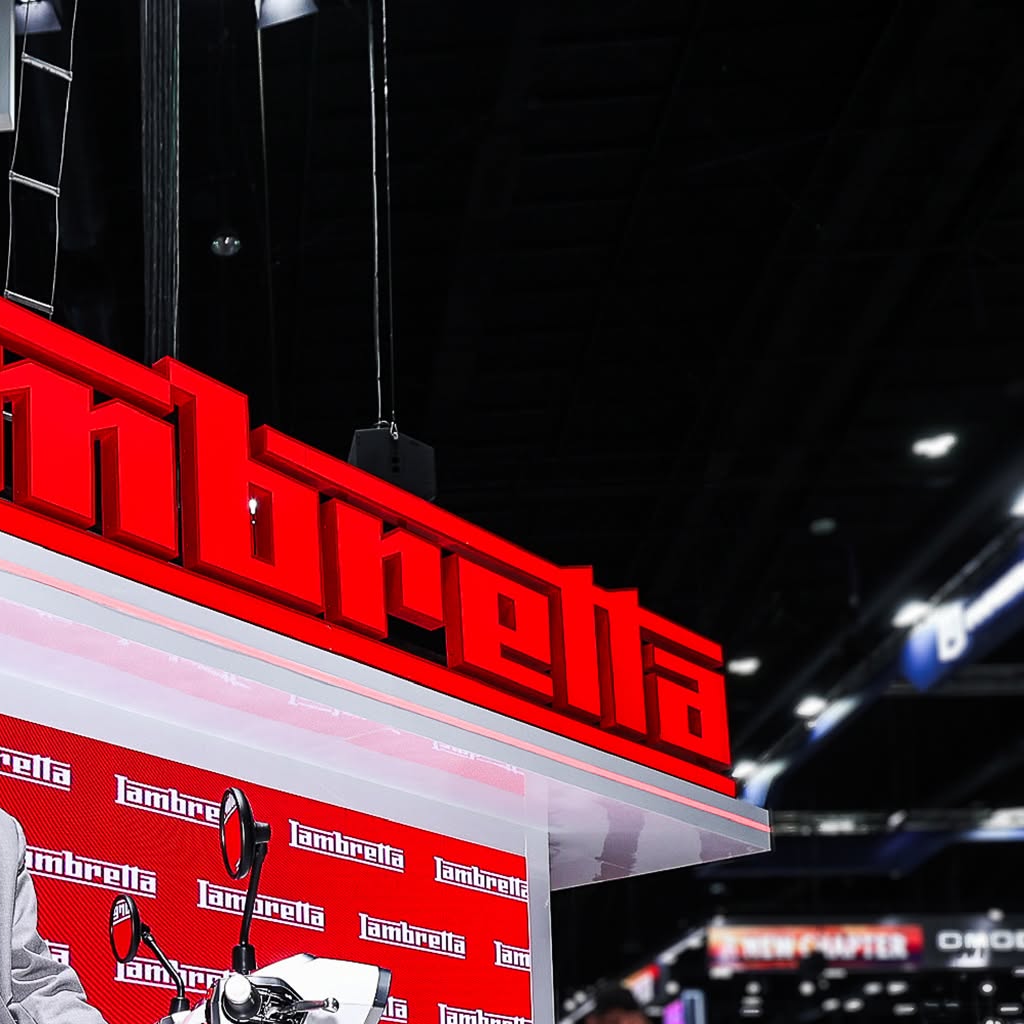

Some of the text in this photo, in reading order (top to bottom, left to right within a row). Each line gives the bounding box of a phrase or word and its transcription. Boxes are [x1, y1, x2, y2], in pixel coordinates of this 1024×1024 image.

[114, 774, 221, 829] Lambre
[26, 845, 157, 899] mbretta
[288, 818, 405, 874] Lambretta
[358, 912, 466, 960] Lambretta
